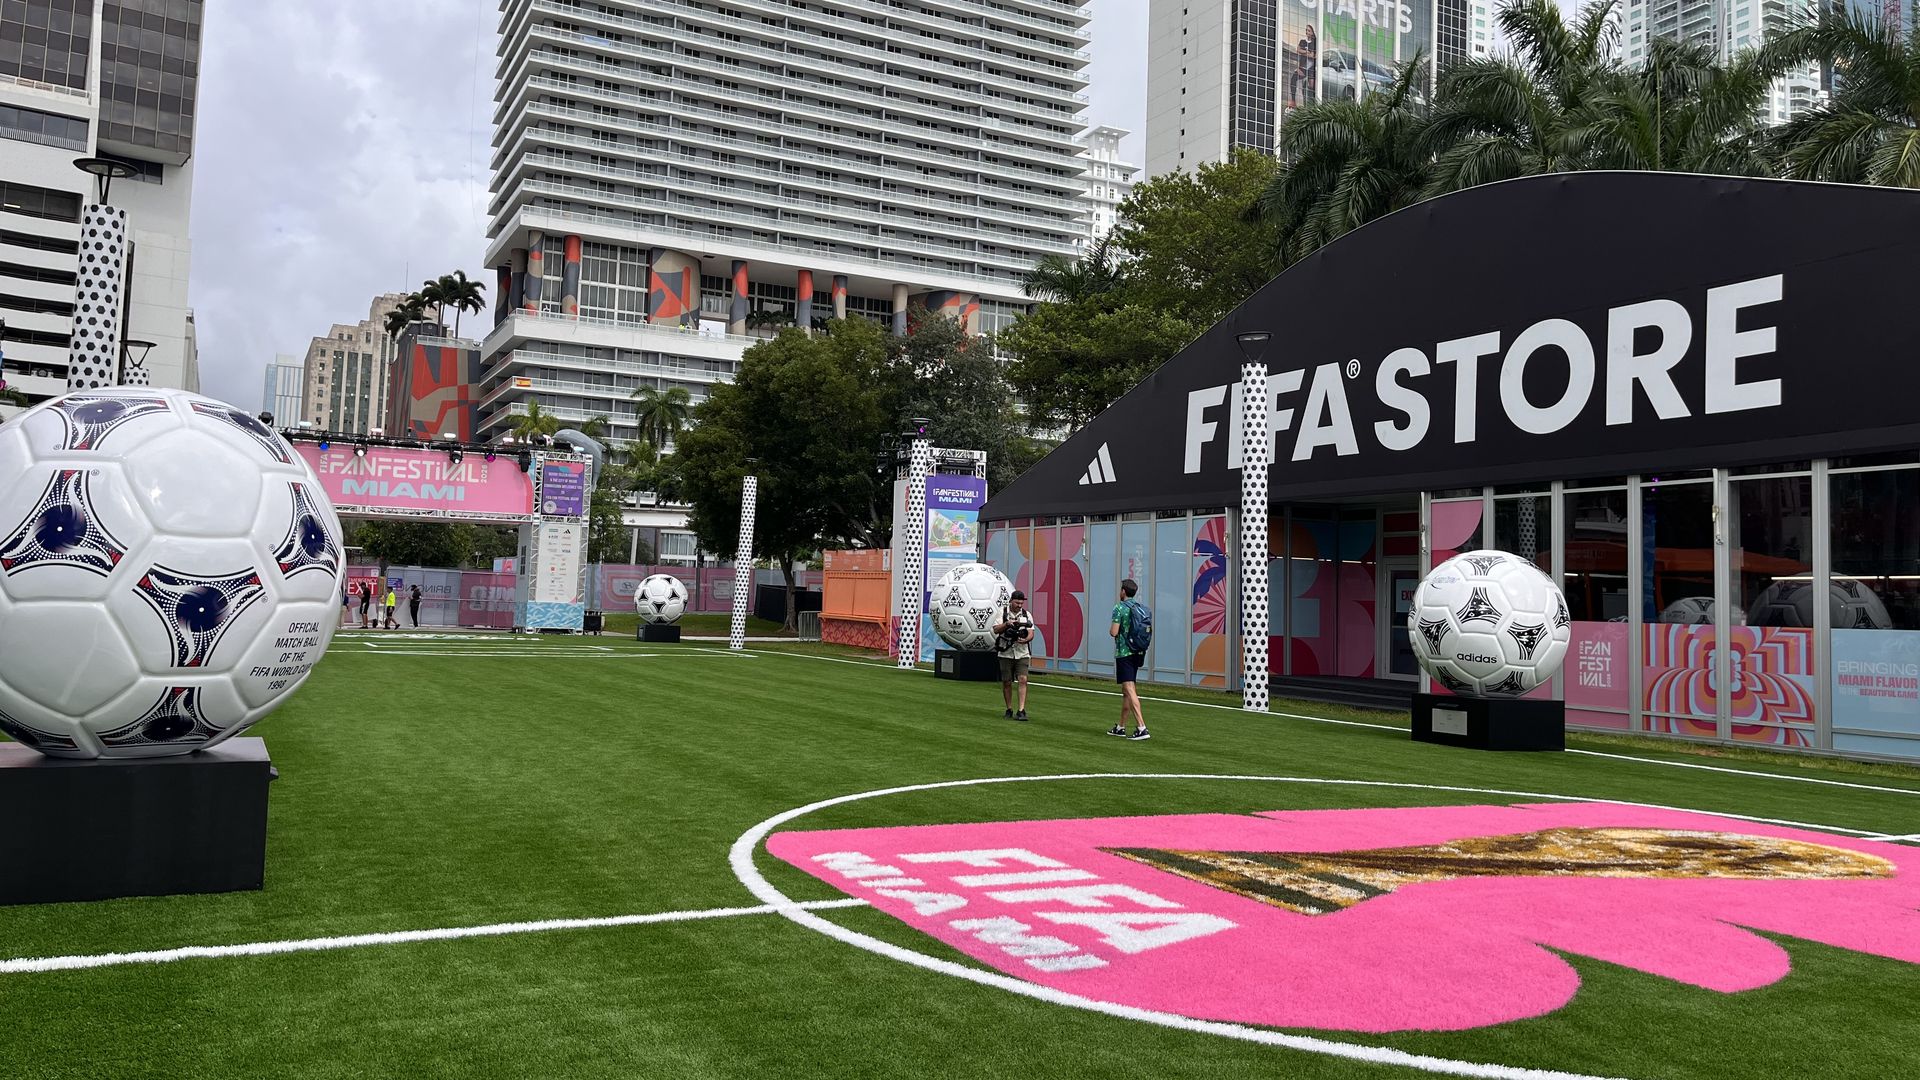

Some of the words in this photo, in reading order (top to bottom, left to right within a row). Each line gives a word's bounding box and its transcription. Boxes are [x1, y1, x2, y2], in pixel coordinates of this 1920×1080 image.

[1301, 0, 1413, 34] ARTS
[1374, 273, 1783, 451] STORE
[341, 478, 465, 502] MIAMI
[938, 496, 973, 504] MIAMI
[288, 622, 319, 633] OFFICIAL
[274, 637, 303, 648] MATCH
[303, 636, 319, 648] BALL
[1584, 640, 1612, 656] FAN
[279, 652, 292, 663] OF
[291, 651, 307, 662] THE
[1456, 651, 1498, 664] adidas
[1579, 655, 1612, 672] FEST
[250, 666, 271, 677] FIFA
[271, 665, 298, 677] WORLD
[1837, 660, 1919, 676] BRINGING
[1838, 674, 1874, 687] MIAMI
[1875, 675, 1919, 689] FLAVOR
[1858, 688, 1897, 698] BEAUTIFUL
[1897, 690, 1919, 700] GAME
[897, 848, 1240, 954] FIFA
